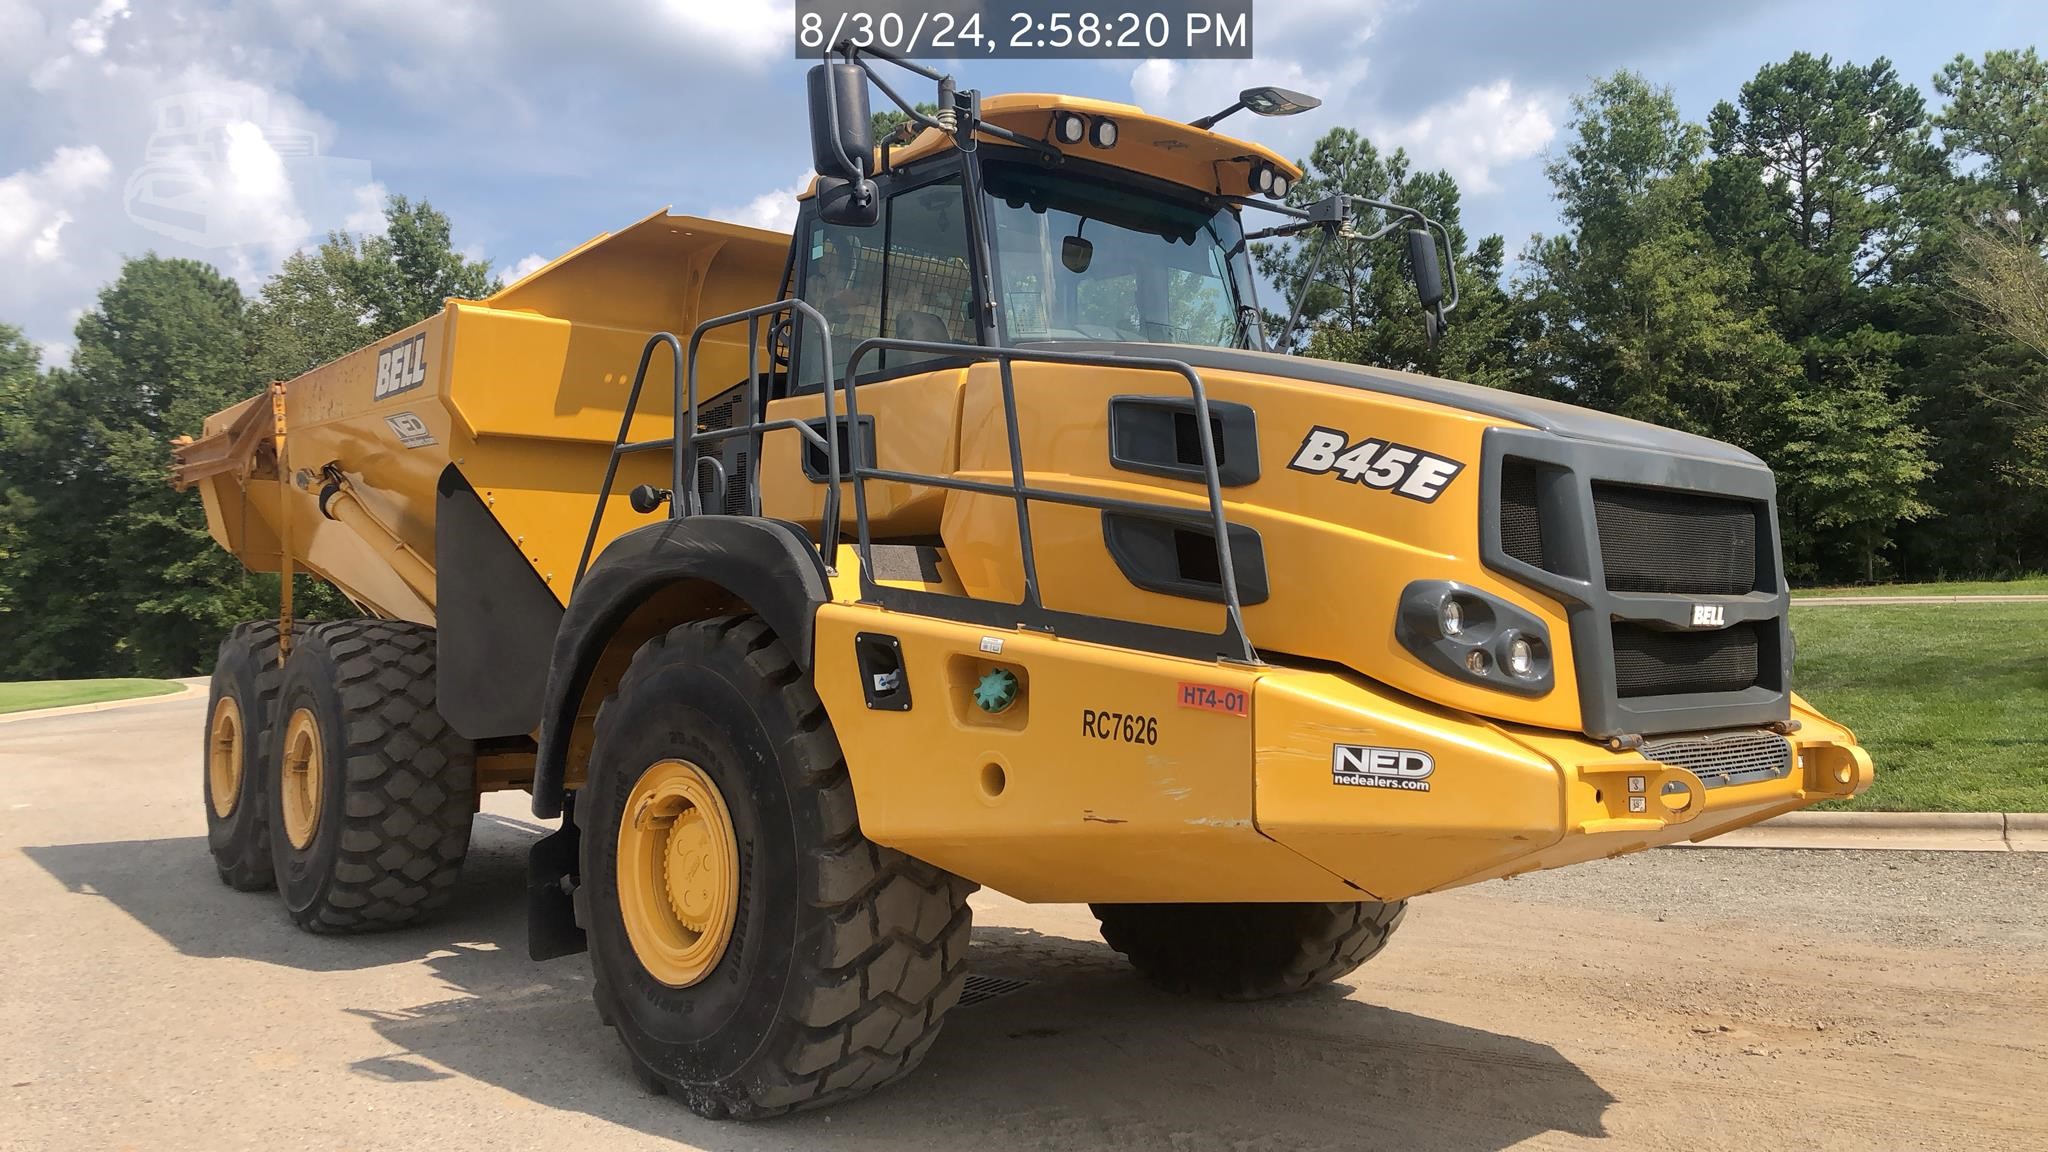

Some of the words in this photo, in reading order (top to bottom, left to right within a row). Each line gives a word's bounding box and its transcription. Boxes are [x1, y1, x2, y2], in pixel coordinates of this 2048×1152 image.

[375, 334, 426, 400] BELL
[386, 412, 429, 439] NED
[1291, 428, 1461, 501] B45E
[1693, 605, 1725, 626] BELL
[1183, 686, 1244, 712] HT4-01
[1082, 709, 1158, 746] RC7626
[1335, 746, 1433, 777] NED
[1334, 774, 1430, 791] nedealers.com
